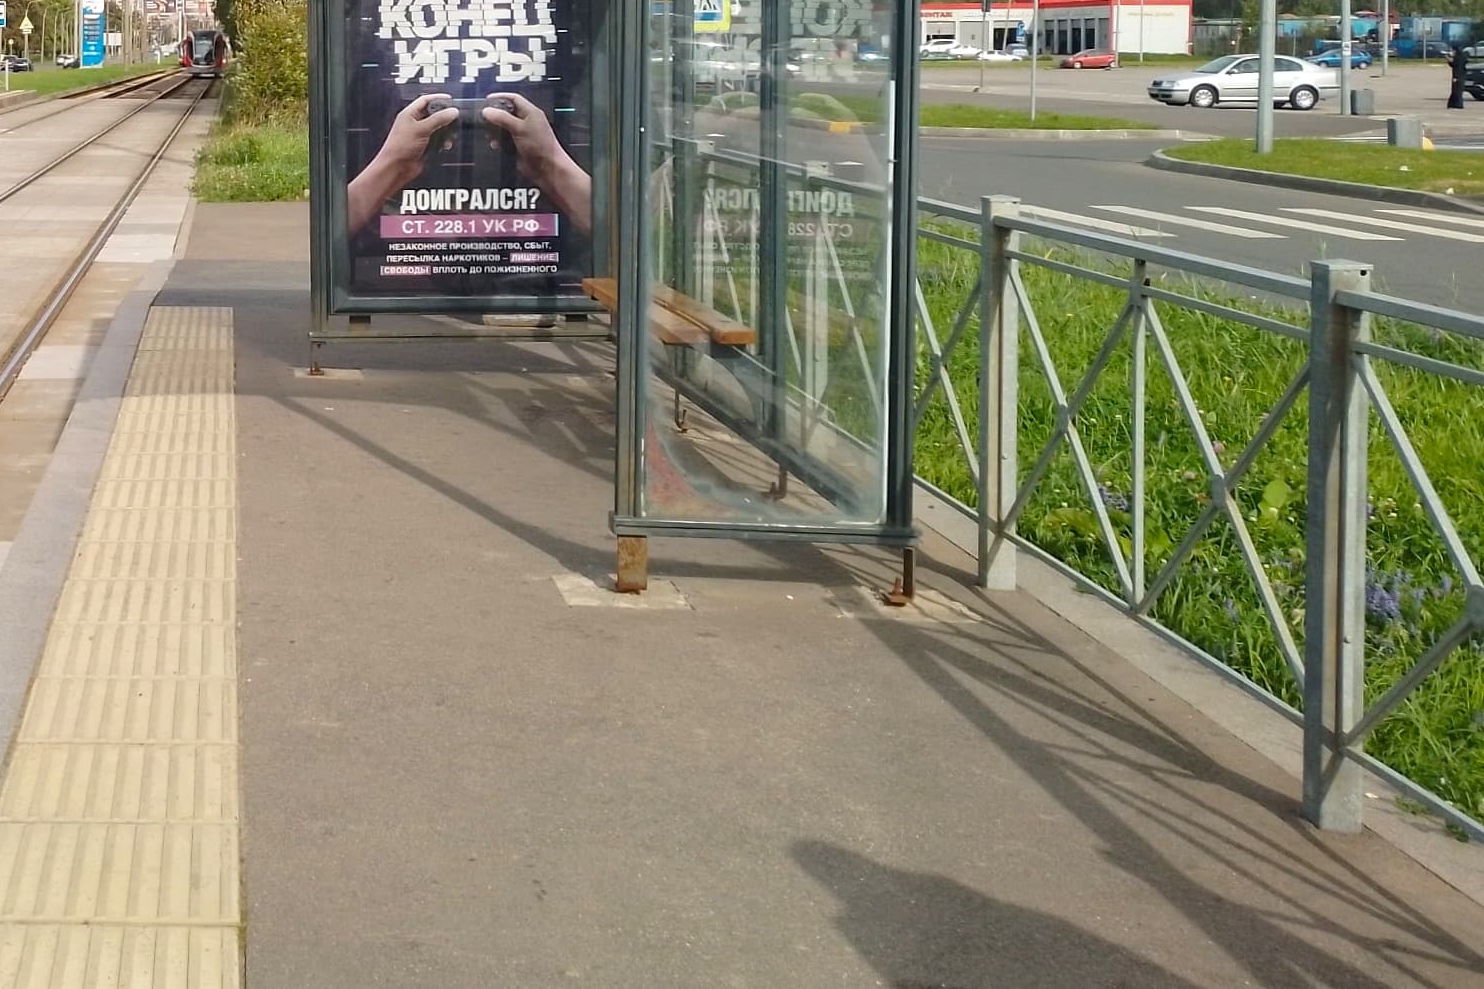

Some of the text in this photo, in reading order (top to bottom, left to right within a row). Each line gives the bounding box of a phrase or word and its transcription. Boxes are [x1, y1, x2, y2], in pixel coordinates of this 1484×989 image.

[393, 38, 547, 84] ИГРЫ
[400, 188, 541, 214] ДОИГРАЛСЯ?
[402, 218, 539, 234] СТ. 228.1 УК РФ
[388, 242, 448, 251] НЕЗАКОННОЕ
[386, 255, 441, 263] ПЕРЕСЫЛКА
[442, 254, 501, 262] НАРКОТИКОВ
[432, 266, 468, 274] ВПЛОТЬ
[469, 265, 483, 274] ДО
[484, 265, 558, 273] ПОЖИЗНЕННОГО
